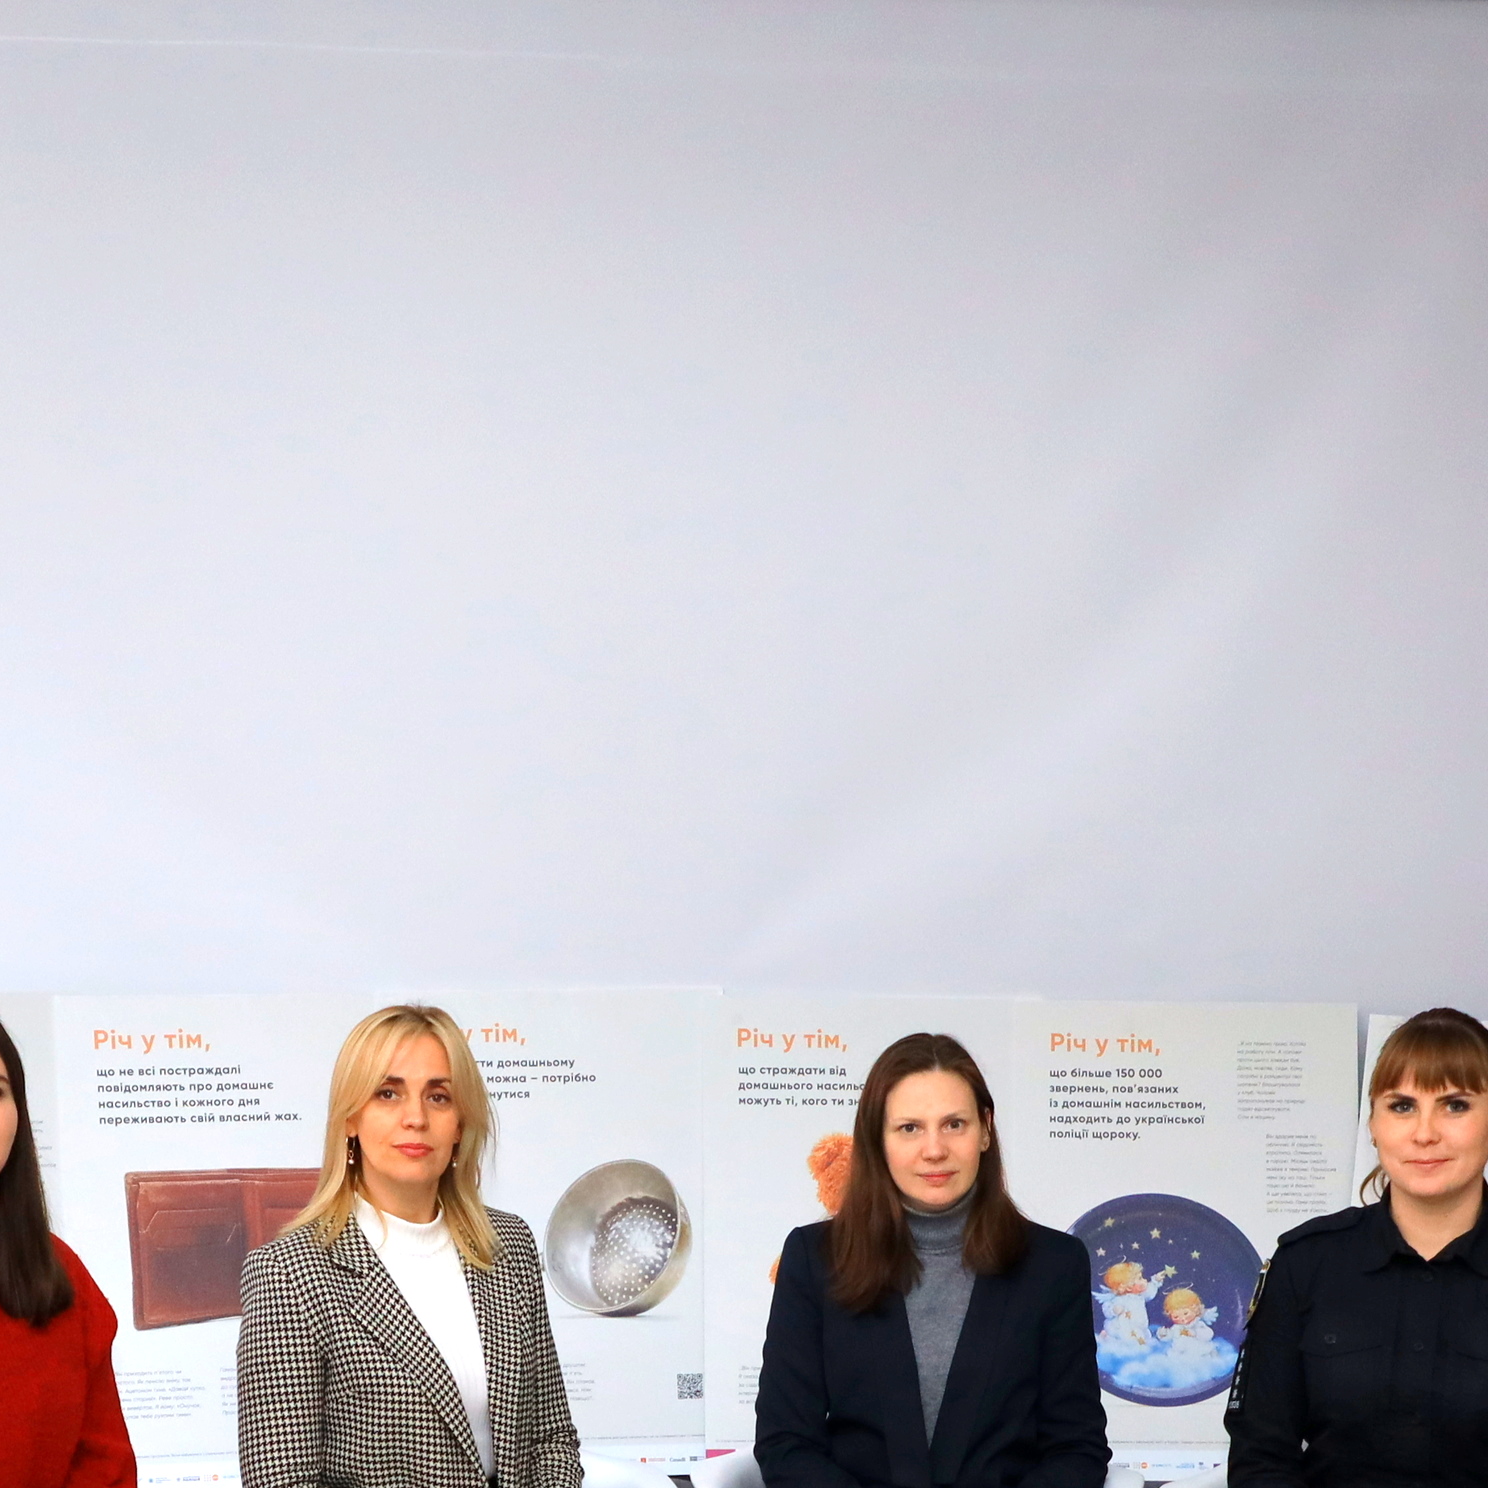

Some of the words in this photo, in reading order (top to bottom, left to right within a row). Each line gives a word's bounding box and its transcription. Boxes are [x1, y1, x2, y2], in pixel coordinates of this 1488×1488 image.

[481, 1023, 526, 1046] тім,
[737, 1028, 773, 1048] Річ
[782, 1033, 796, 1053] у
[803, 1029, 848, 1052] тім,
[93, 1029, 133, 1050] Річ
[141, 1034, 156, 1055] у
[164, 1028, 211, 1052] тім,
[1050, 1033, 1087, 1053] Річ
[1095, 1038, 1109, 1057] у
[1117, 1034, 1161, 1056] тім,
[497, 1059, 575, 1069] домашньому
[96, 1067, 116, 1078] що
[119, 1068, 134, 1077] не
[138, 1066, 155, 1076] всі
[159, 1064, 241, 1078] постраждалі
[738, 1066, 756, 1077] що
[759, 1066, 826, 1077] страждати
[829, 1065, 847, 1077] від
[1049, 1069, 1067, 1079] що
[1070, 1068, 1112, 1078] більше
[1116, 1068, 1135, 1078] 150
[1139, 1068, 1162, 1078] 000
[486, 1076, 527, 1084] можна
[542, 1073, 597, 1085] потрібно
[97, 1082, 186, 1094] повідомляють
[189, 1082, 213, 1094] про
[216, 1081, 274, 1094] домашнє
[738, 1081, 813, 1091] домашнього
[817, 1082, 865, 1091] насильс
[1049, 1084, 1109, 1095] звернень,
[489, 1090, 530, 1101] нутися
[98, 1099, 172, 1109] насильство
[175, 1097, 179, 1107] і
[182, 1098, 235, 1108] кожного
[238, 1097, 260, 1108] дня
[738, 1097, 782, 1108] можуть
[785, 1096, 798, 1107] ті,
[802, 1097, 828, 1106] кого
[832, 1098, 844, 1106] ти
[1049, 1098, 1058, 1108] із
[1061, 1098, 1121, 1110] домашнім
[1125, 1100, 1206, 1111] насильством,
[99, 1115, 187, 1127] переживають
[190, 1112, 216, 1124] свій
[219, 1111, 271, 1123] власний
[274, 1111, 302, 1122] жах.
[1049, 1114, 1113, 1125] надходить
[1116, 1115, 1131, 1125] до
[1134, 1114, 1205, 1126] української
[1049, 1128, 1089, 1140] поліції
[1092, 1130, 1141, 1141] щороку.
